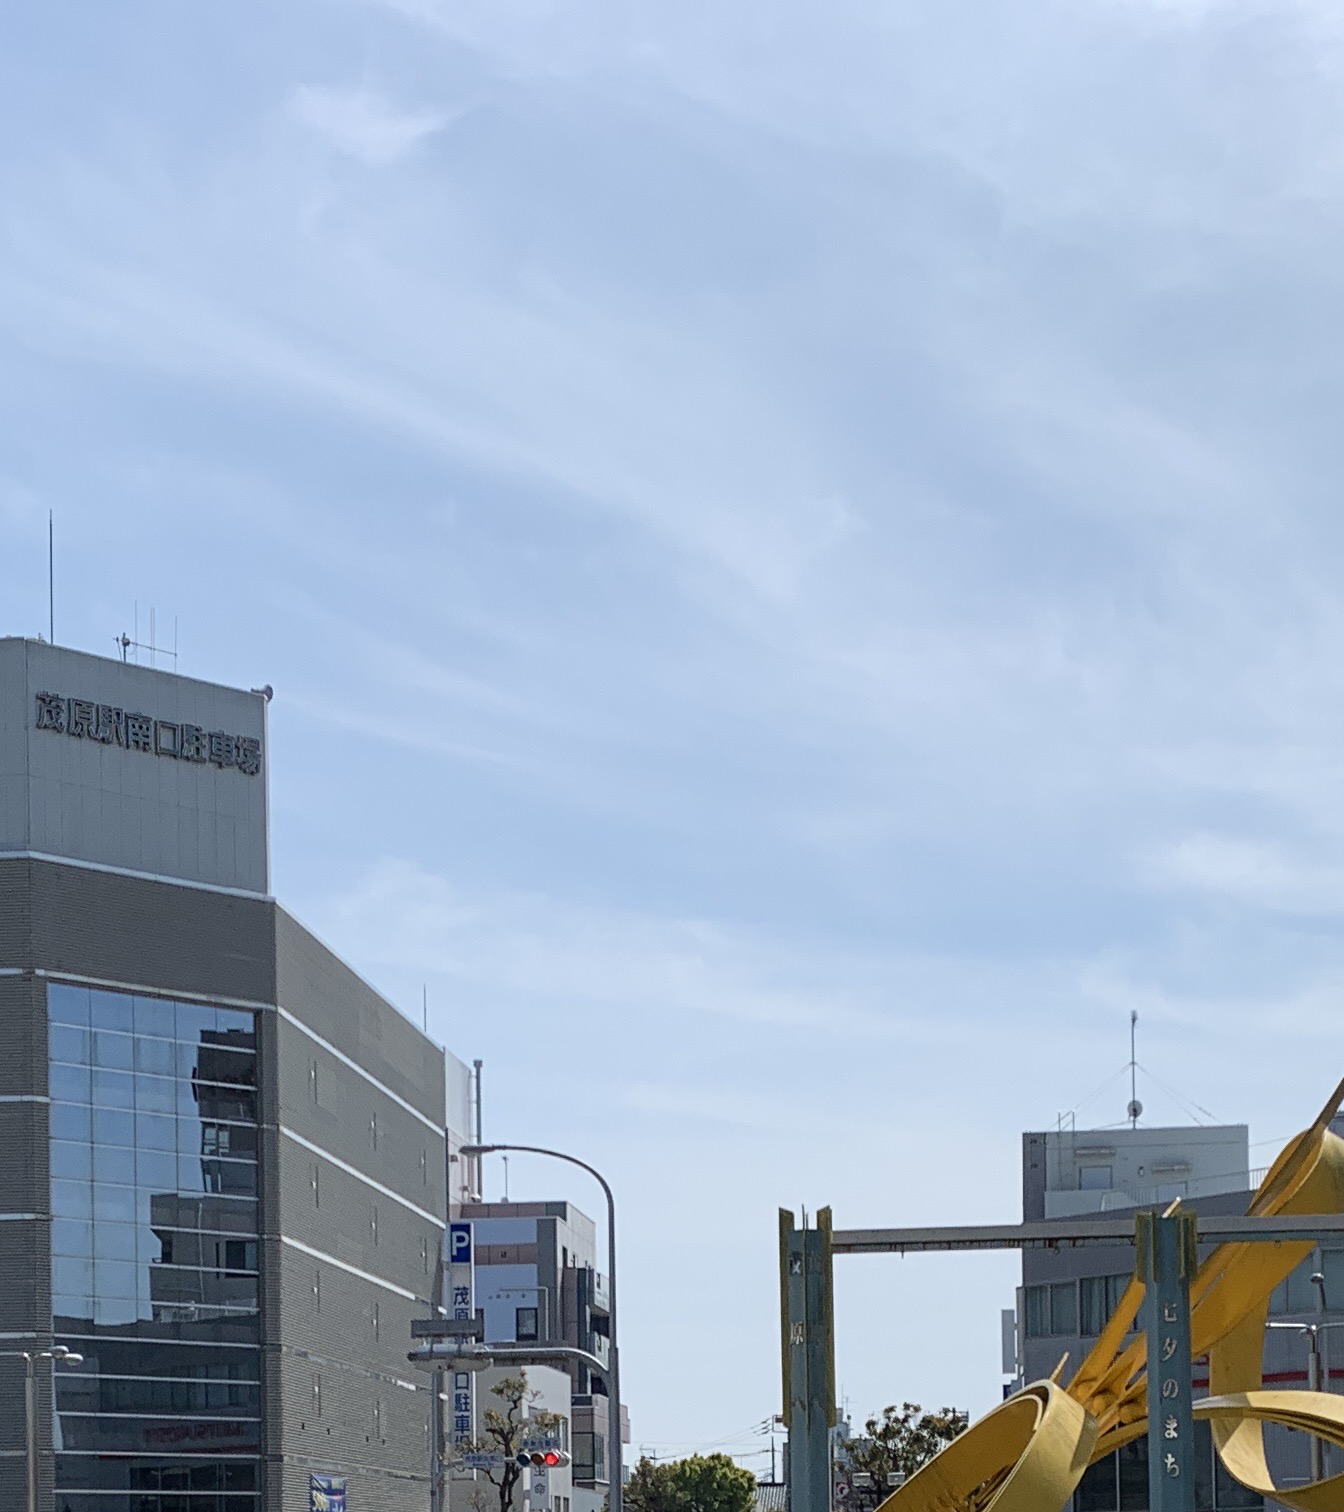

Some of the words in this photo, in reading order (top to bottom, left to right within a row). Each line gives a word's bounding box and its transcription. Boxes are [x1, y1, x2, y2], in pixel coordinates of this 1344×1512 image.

[36, 691, 263, 776] 茂原駅南口駐車場
[452, 1231, 469, 1256] P
